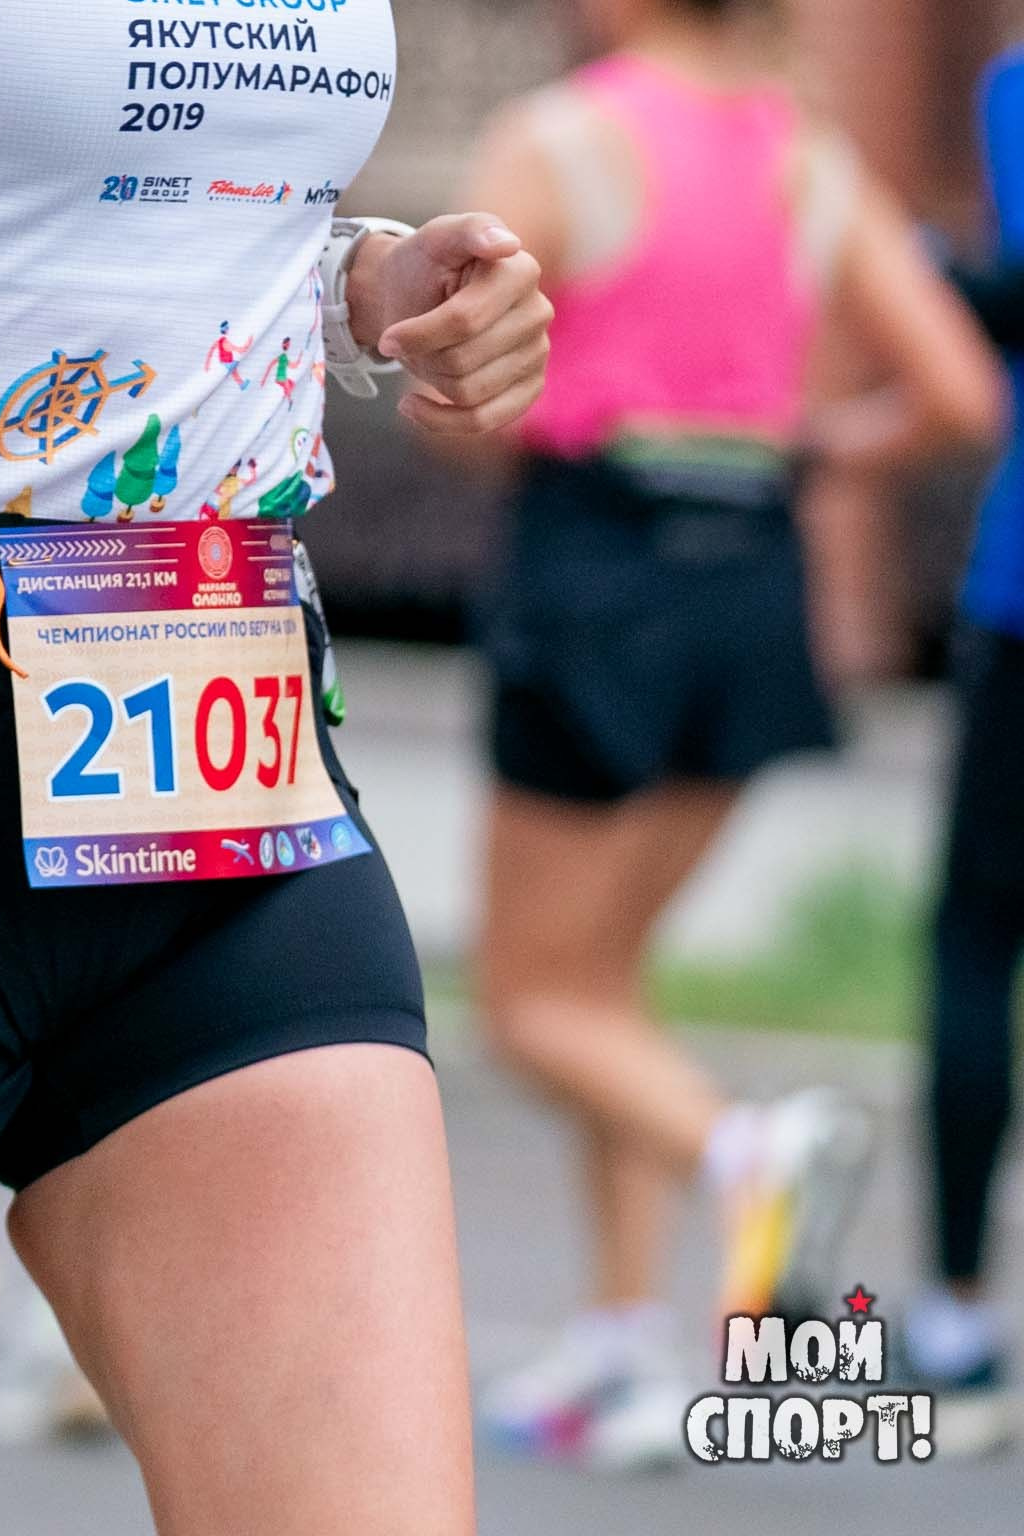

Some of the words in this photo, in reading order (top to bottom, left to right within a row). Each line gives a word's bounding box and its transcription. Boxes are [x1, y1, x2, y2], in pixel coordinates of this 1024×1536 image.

[128, 18, 317, 54] ЯКУТСКИЙ
[128, 61, 391, 101] ПОЛУМАРАФОН
[118, 102, 205, 133] 2019
[99, 174, 138, 204] 20
[141, 189, 189, 198] GROUP
[143, 176, 193, 189] SINET
[17, 573, 123, 595] ДИСТАНЦИЯ
[126, 573, 151, 589] 21,1
[154, 571, 178, 587] КМ
[37, 624, 159, 644] ЧЕМПИОНАТ
[165, 620, 227, 640] РОССИИ
[230, 620, 247, 637] ПО
[42, 675, 303, 798] 21037
[75, 843, 197, 876] Skintime
